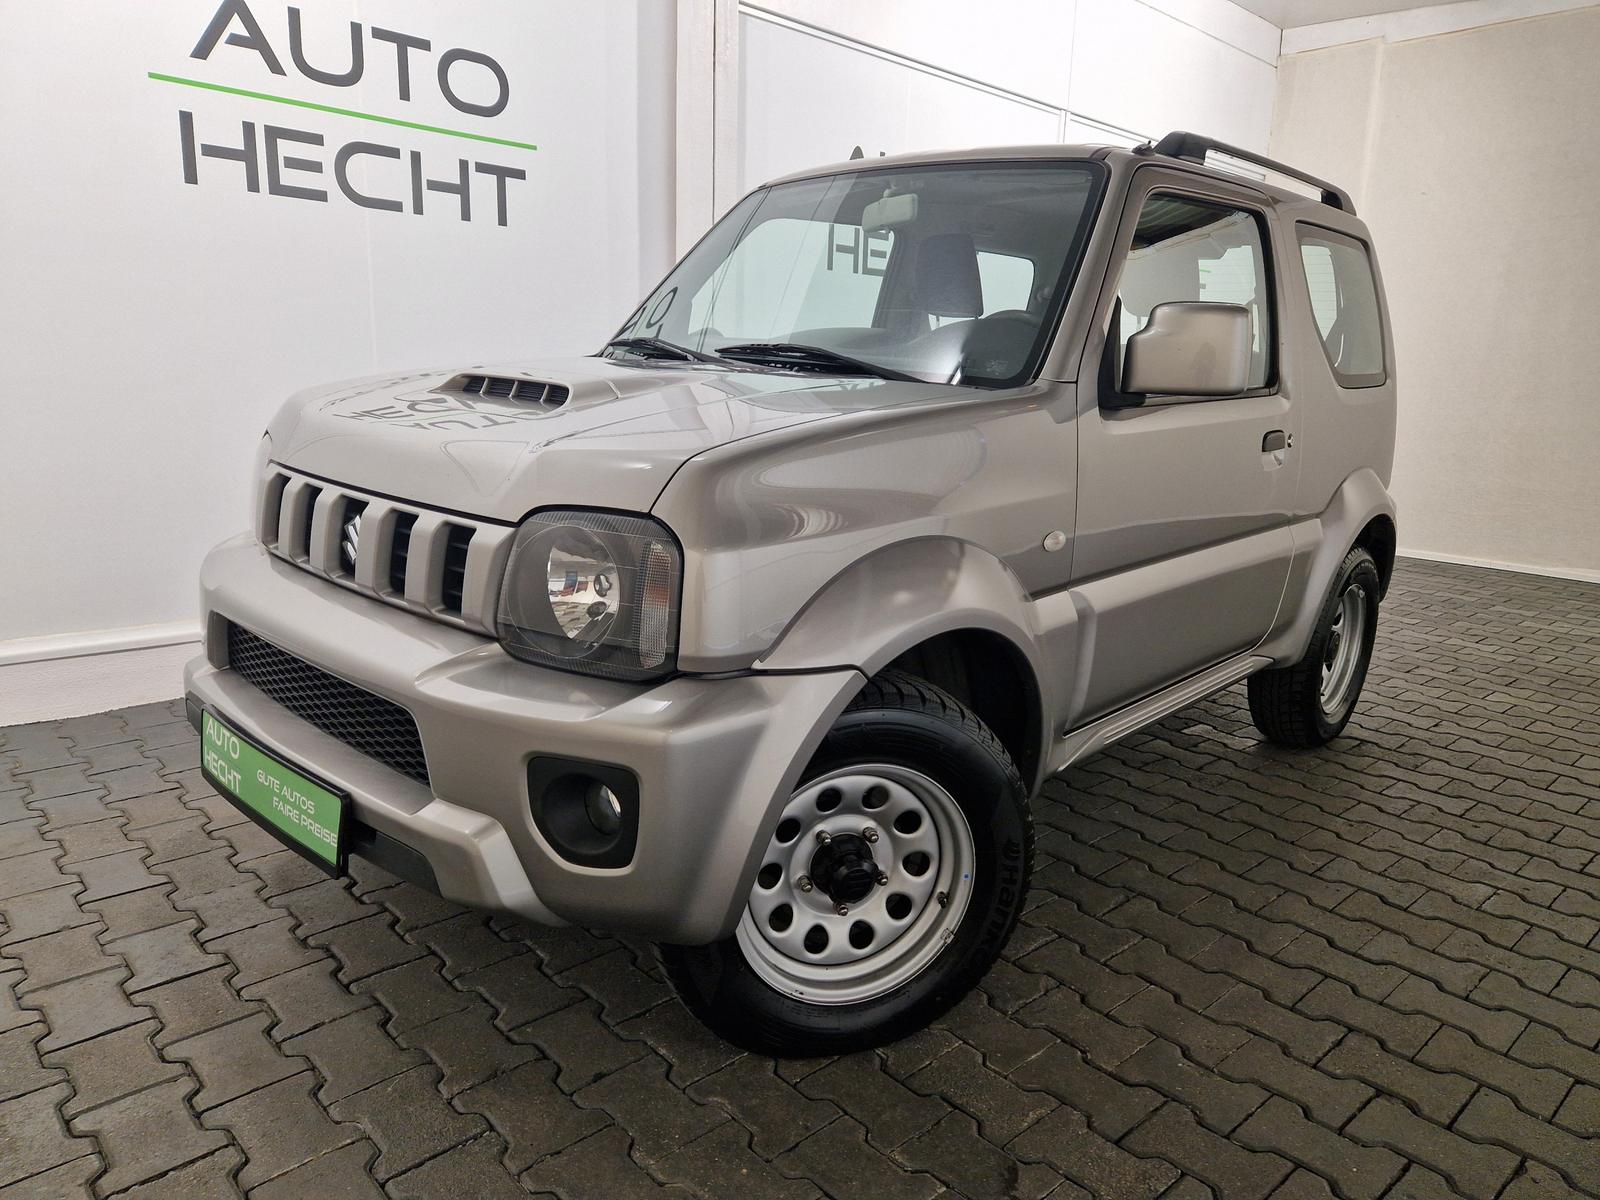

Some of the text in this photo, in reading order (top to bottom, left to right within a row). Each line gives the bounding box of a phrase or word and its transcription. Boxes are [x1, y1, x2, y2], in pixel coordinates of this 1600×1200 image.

[190, 0, 510, 118] AUTO
[178, 109, 527, 227] HECHT
[206, 718, 239, 759] AUTO
[205, 747, 241, 793] HECHT
[257, 770, 315, 813] GUTE AUTOS
[273, 797, 337, 847] FAIRE PREISE
